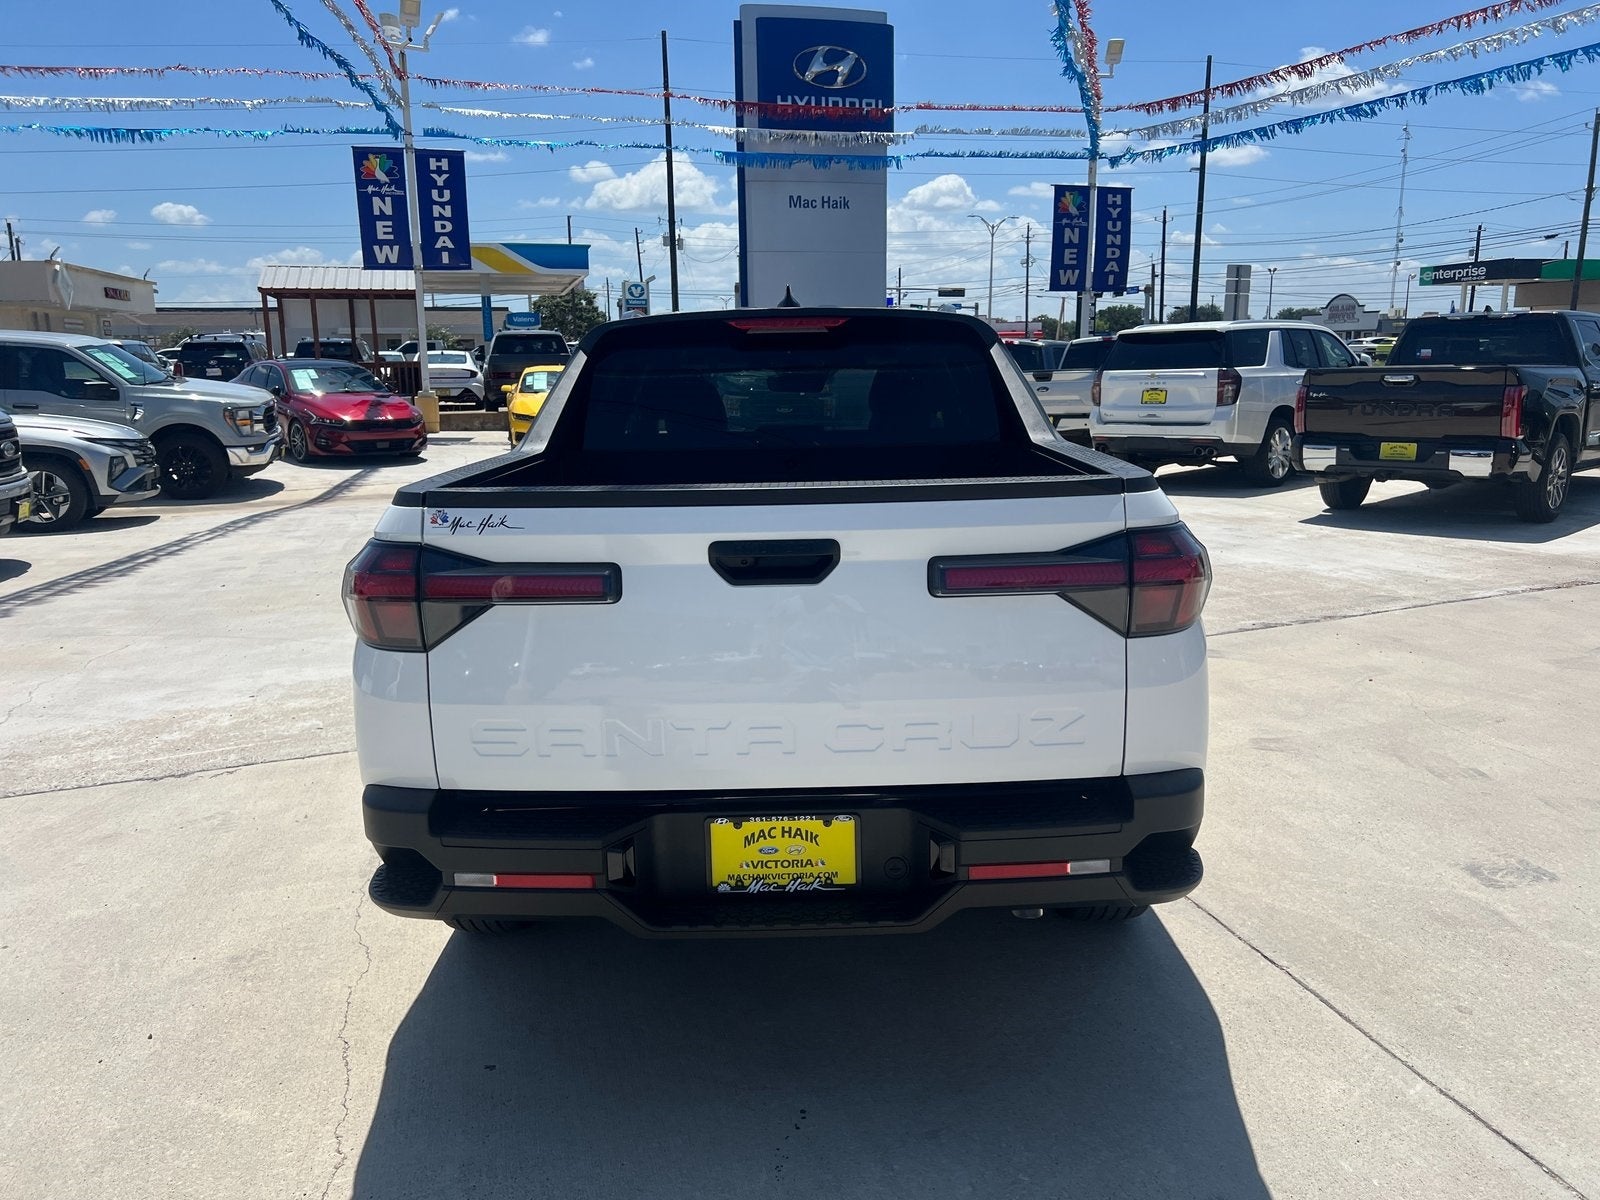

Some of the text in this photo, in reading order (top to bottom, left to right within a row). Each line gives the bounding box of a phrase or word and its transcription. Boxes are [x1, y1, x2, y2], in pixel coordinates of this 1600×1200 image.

[429, 158, 455, 264] HYUNDAI
[788, 195, 850, 210] Mac Haik
[372, 196, 400, 264] NEW
[1104, 194, 1122, 286] HYUNDAI
[1058, 228, 1080, 286] NEW
[1423, 265, 1487, 281] enterprise
[1344, 402, 1455, 417] TUNDRA
[448, 514, 518, 535] Mac Haik
[470, 705, 1088, 759] SANTA CRUZ
[743, 826, 821, 849] MAC HAIK
[750, 859, 815, 869] VICTORIA
[727, 871, 839, 881] MACHAIKVICTORIA.COM
[748, 877, 831, 893] Mac Haik
